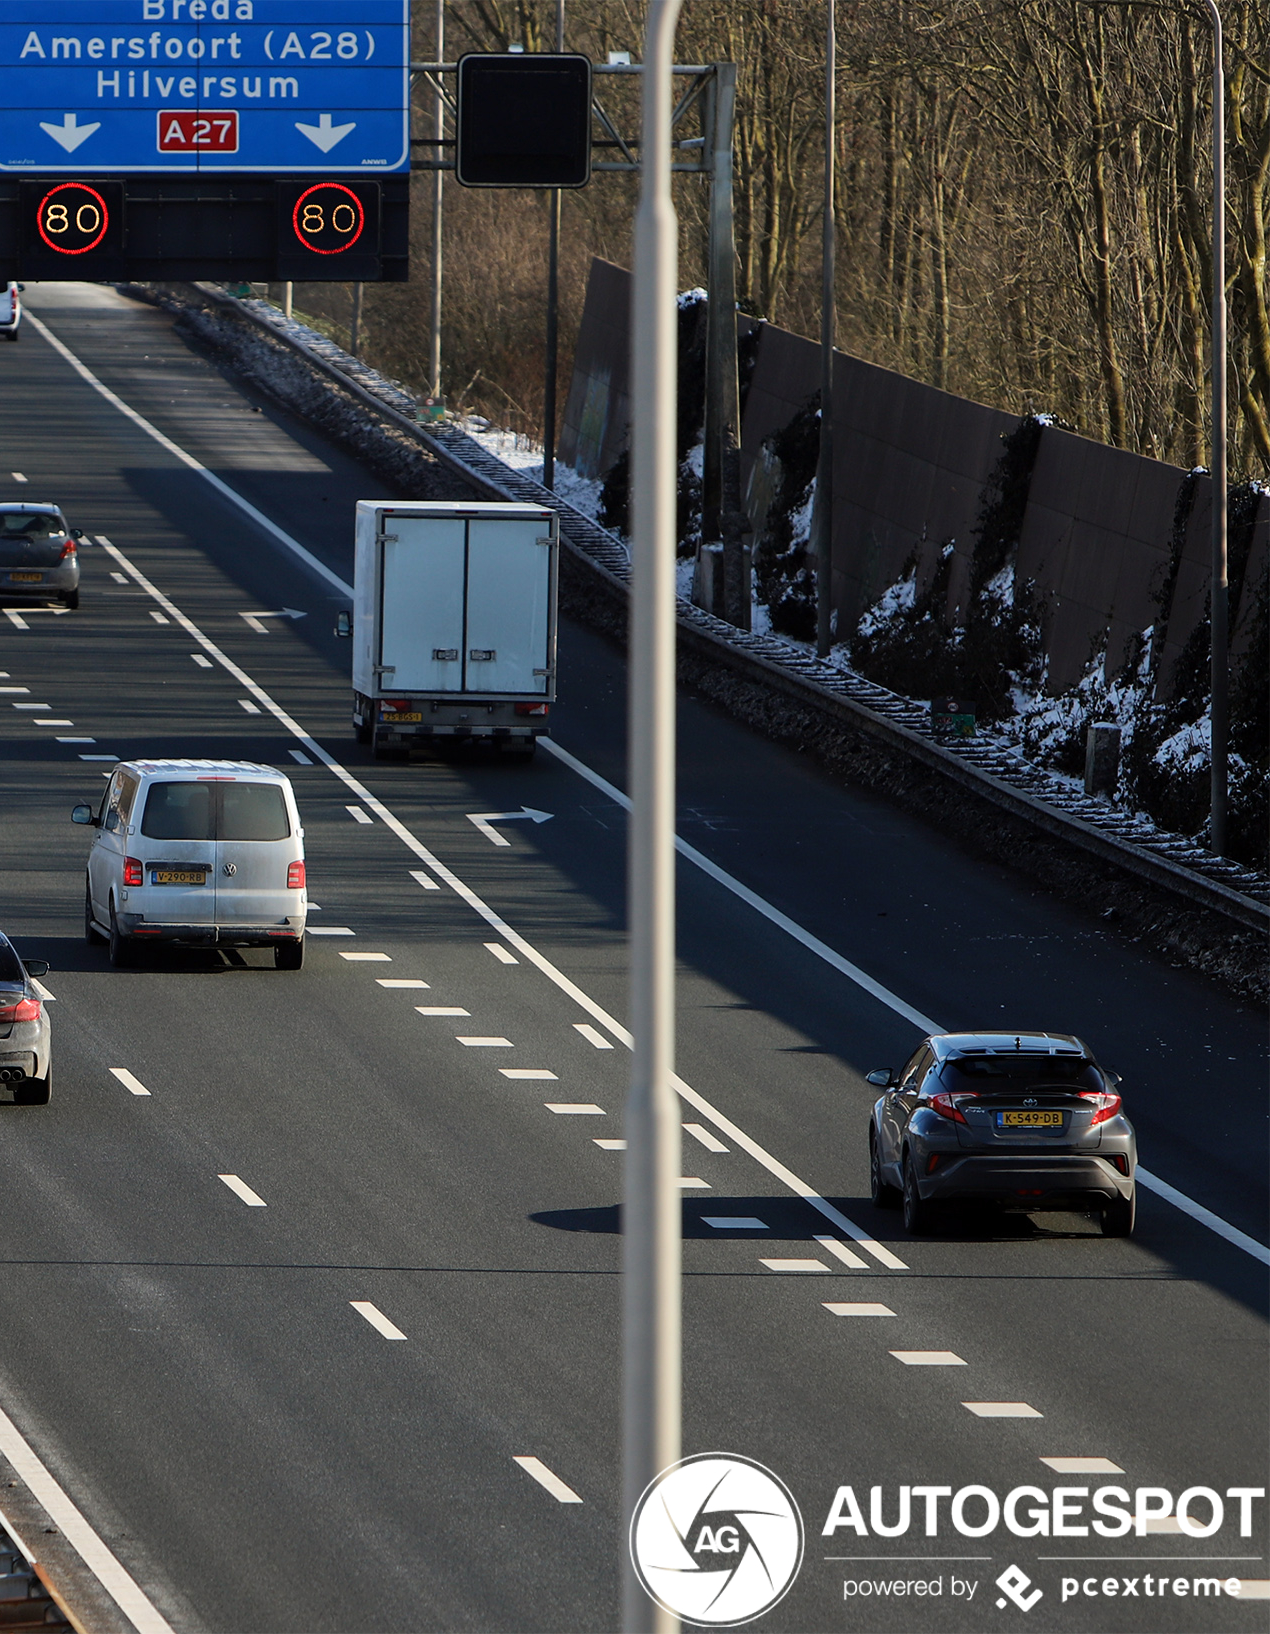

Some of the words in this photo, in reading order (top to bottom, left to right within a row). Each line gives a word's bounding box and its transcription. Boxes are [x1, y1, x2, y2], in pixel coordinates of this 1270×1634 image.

[143, 0, 253, 20] Breda
[20, 31, 242, 59] Amersfoort
[264, 30, 375, 60] (A28)
[97, 70, 299, 98] Hilversum
[164, 120, 232, 143] A27
[46, 204, 100, 233] 80
[302, 204, 355, 233] 80
[158, 873, 202, 882] V-290-RB
[1005, 1113, 1060, 1124] K-549-DB
